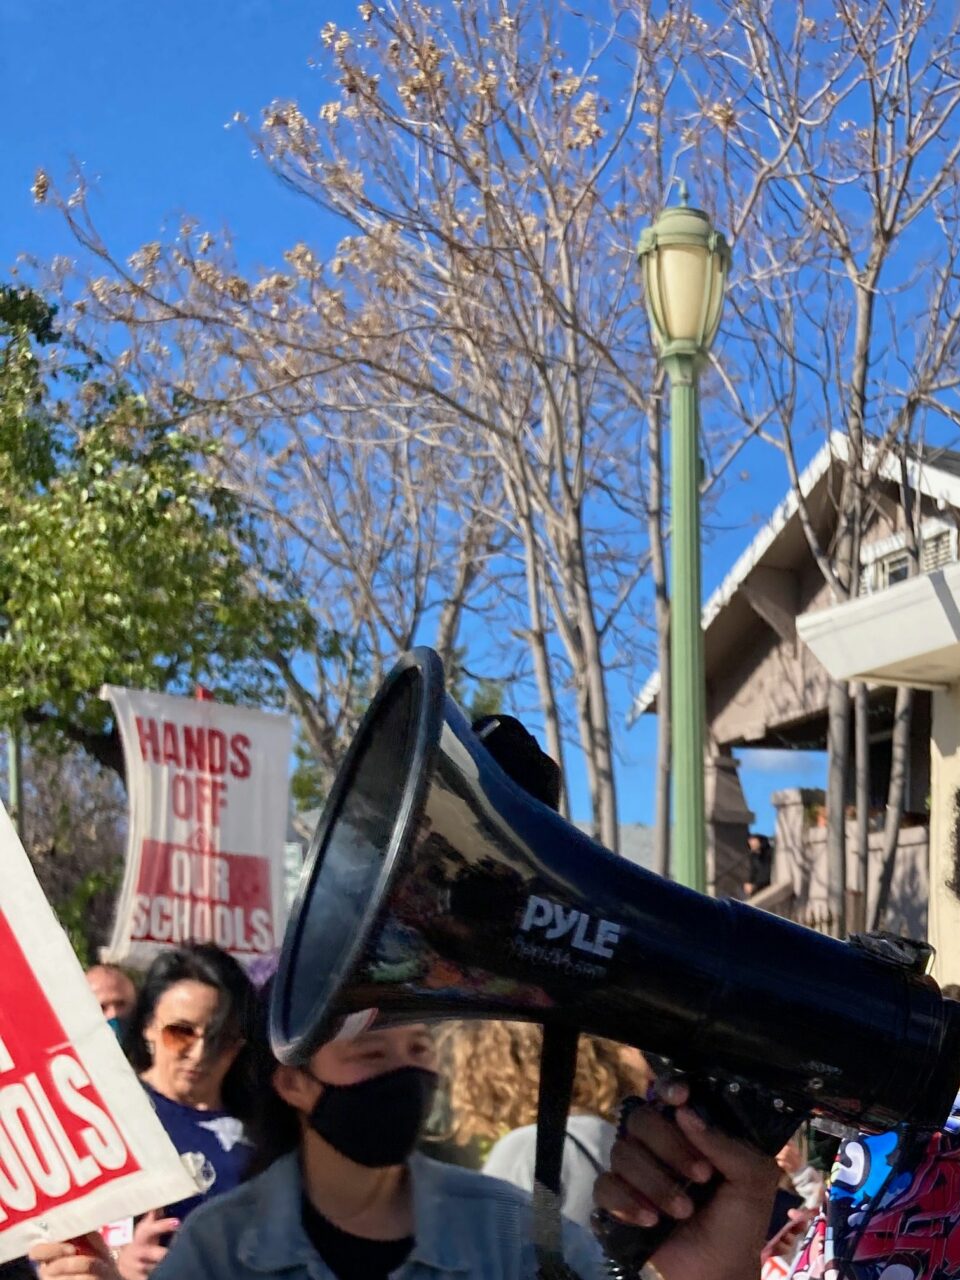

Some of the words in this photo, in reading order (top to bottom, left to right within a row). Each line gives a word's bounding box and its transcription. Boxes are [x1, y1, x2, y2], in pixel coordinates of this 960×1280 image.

[134, 715, 253, 780] HANDS
[172, 773, 229, 827] OFF
[171, 850, 232, 902] OUR
[131, 895, 274, 952] SCHOOLS
[520, 894, 622, 960] PYLE
[0, 1052, 128, 1220] OOLS
